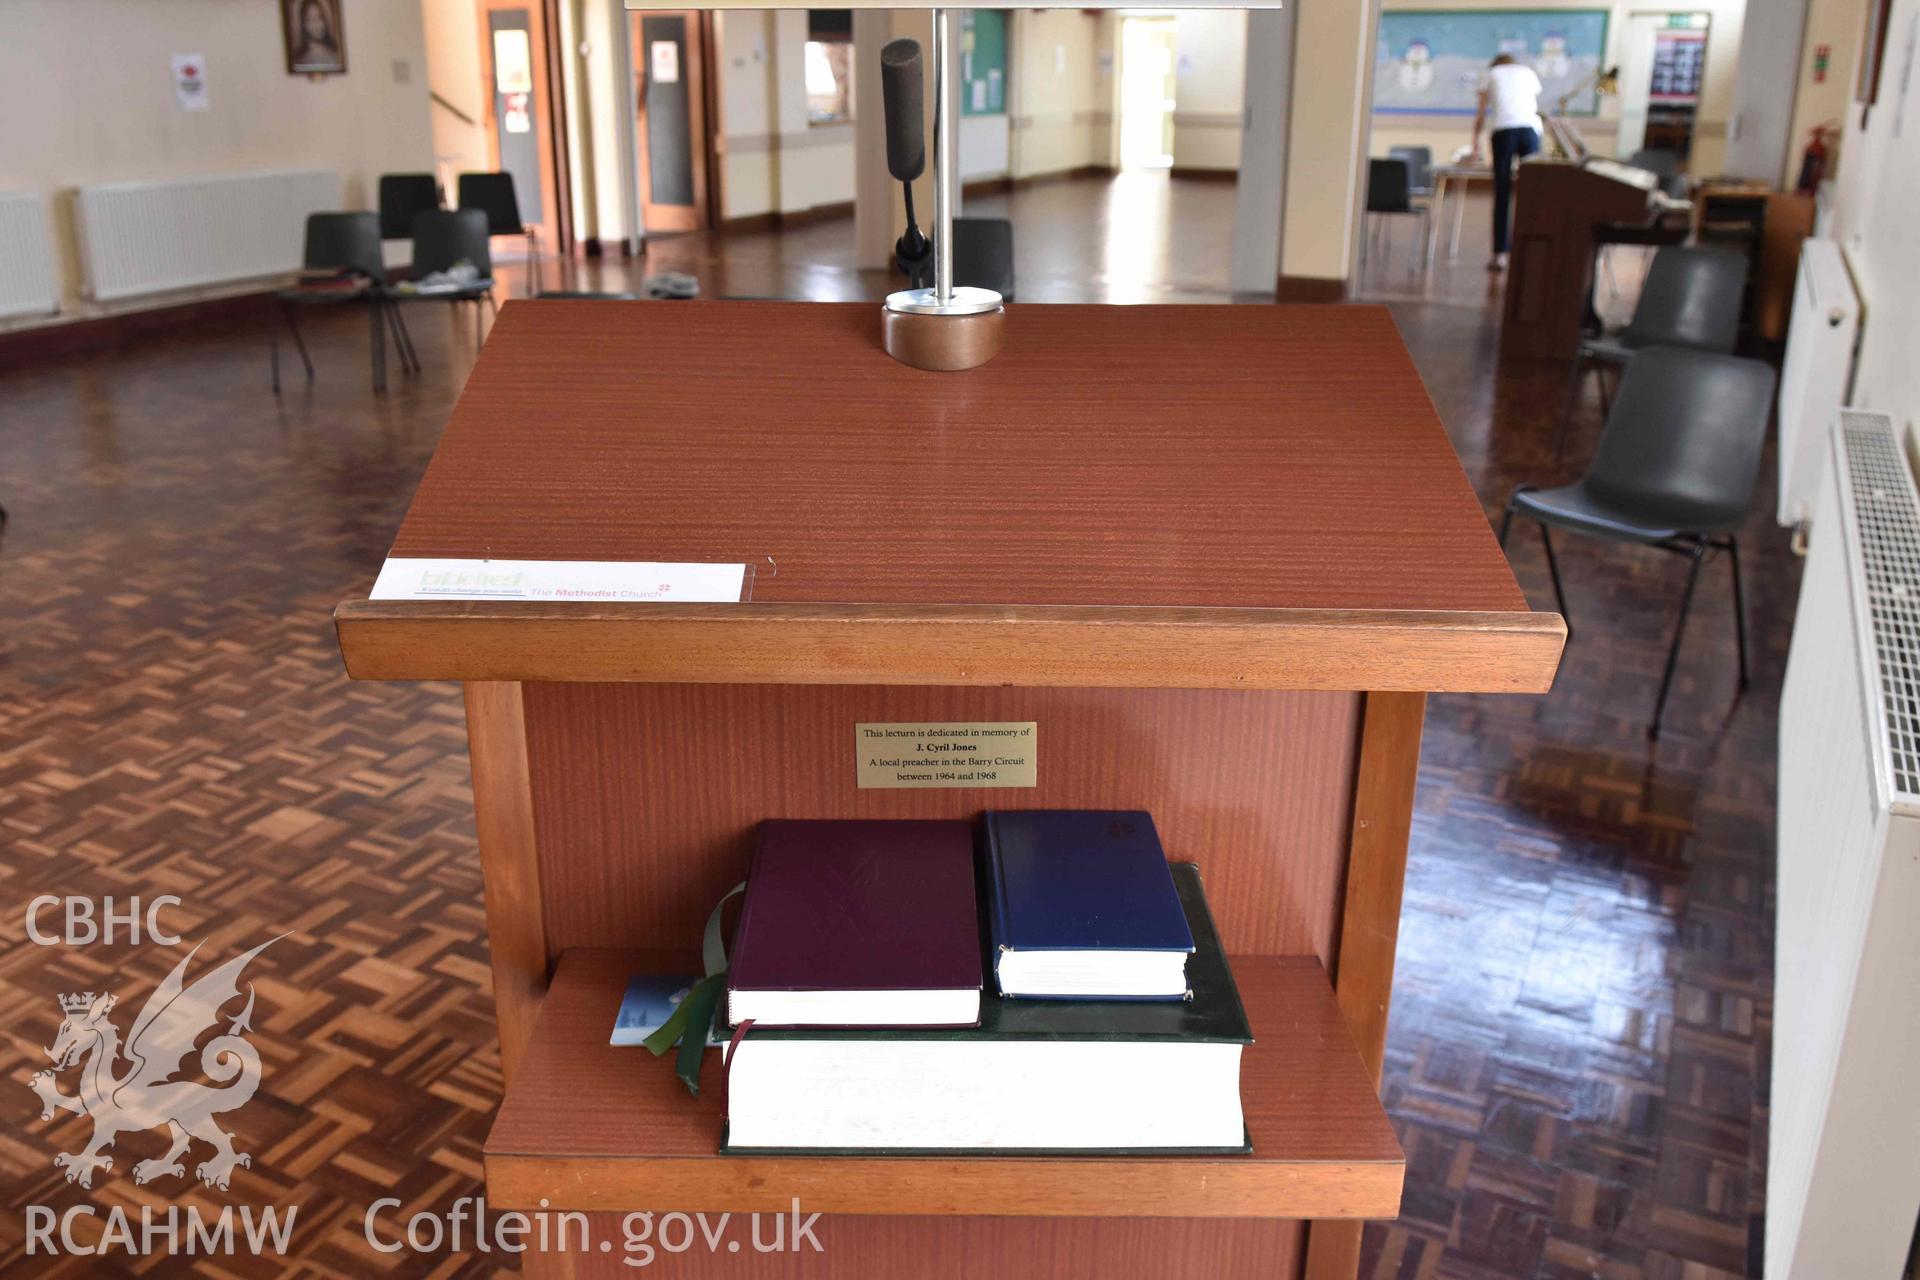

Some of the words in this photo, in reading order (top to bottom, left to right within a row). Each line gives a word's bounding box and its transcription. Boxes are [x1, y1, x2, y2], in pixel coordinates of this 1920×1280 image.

[530, 588, 552, 597] The
[555, 588, 617, 597] Methodist
[620, 589, 662, 598] Church
[864, 729, 883, 738] This
[885, 729, 916, 738] lecturn
[918, 729, 925, 737] is
[927, 729, 969, 737] dedicated
[971, 729, 979, 737] in
[981, 730, 1018, 739] memory
[1020, 728, 1031, 737] of
[916, 743, 924, 752] J.
[926, 743, 950, 753] Cyril
[952, 743, 977, 752] Jones
[869, 758, 877, 767] A
[879, 758, 900, 767] local
[902, 758, 940, 768] preacher
[942, 757, 950, 766] in
[952, 757, 966, 766] the
[968, 758, 992, 768] Barry
[995, 757, 1025, 766] Circuit
[897, 773, 932, 781] between
[935, 773, 955, 781] 1964
[957, 772, 974, 780] and
[976, 772, 997, 780] 1968
